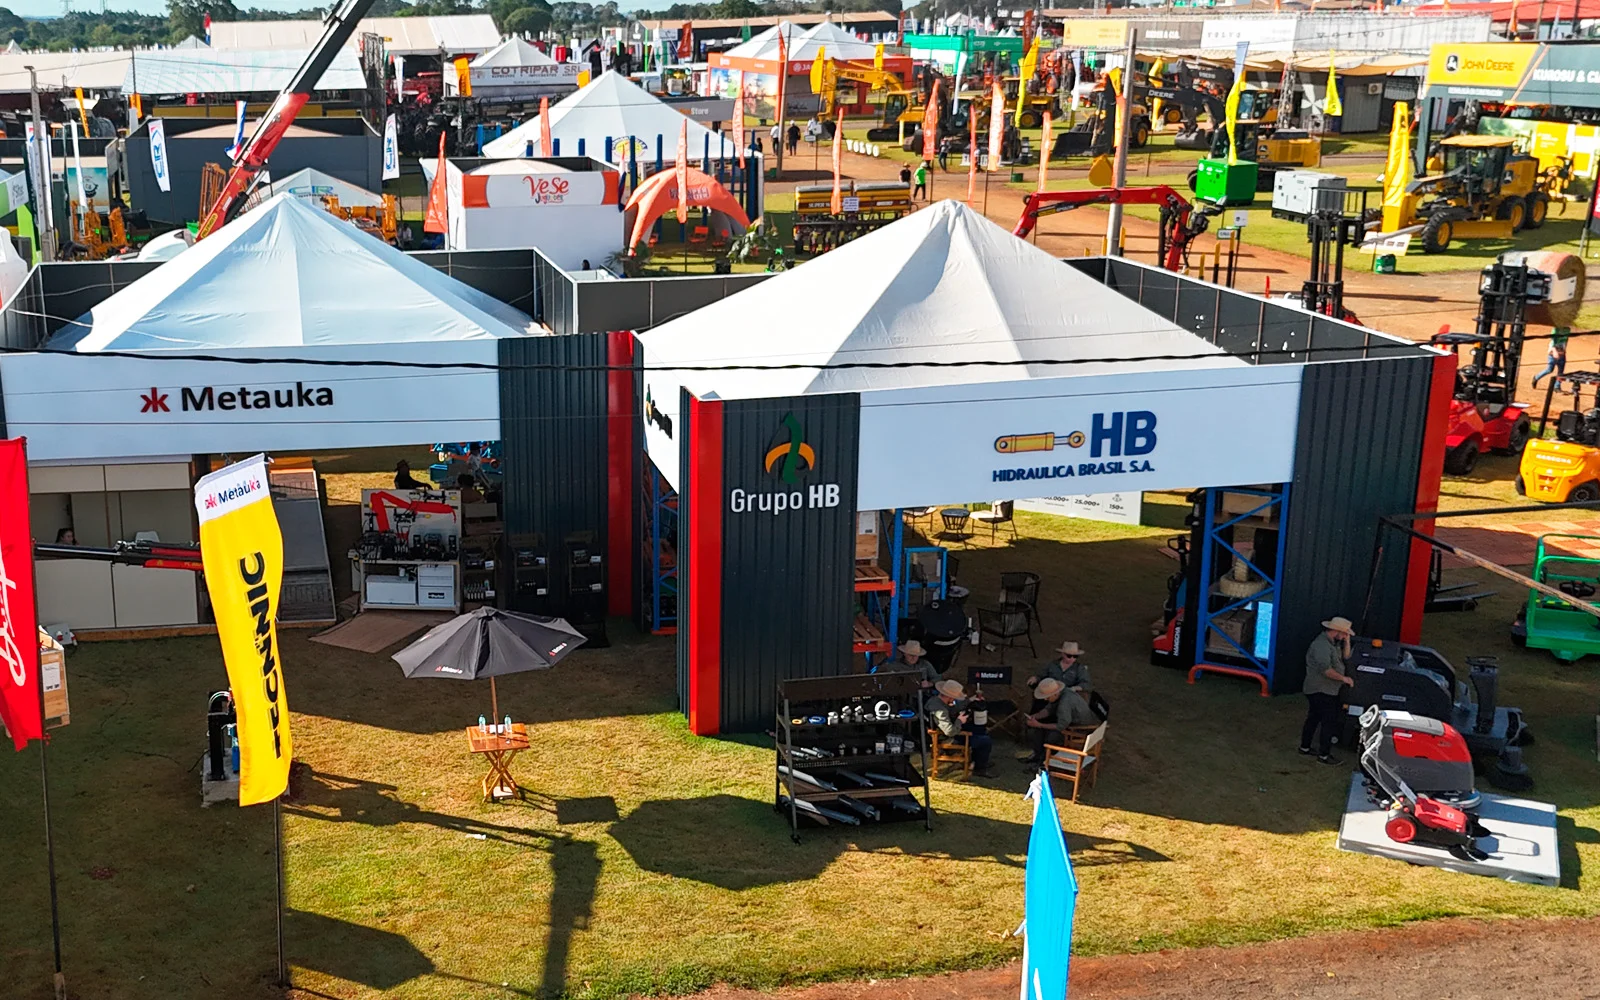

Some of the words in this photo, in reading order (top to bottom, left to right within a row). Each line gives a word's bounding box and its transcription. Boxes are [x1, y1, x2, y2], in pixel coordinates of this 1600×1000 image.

[491, 65, 559, 75] COTRIPAR
[1461, 59, 1484, 70] JOHN
[1486, 59, 1515, 71] DEERE
[1576, 69, 1586, 83] &
[1148, 89, 1175, 98] DEERE
[845, 139, 880, 157] VOLVO
[181, 381, 334, 412] Metauka
[1089, 410, 1157, 458] HB
[992, 464, 1075, 482] HIDRAULICA
[1078, 461, 1127, 476] BRASIL
[1129, 459, 1156, 473] S.A.
[218, 479, 261, 504] Metauka
[730, 488, 803, 516] Grupo
[808, 483, 840, 509] HB
